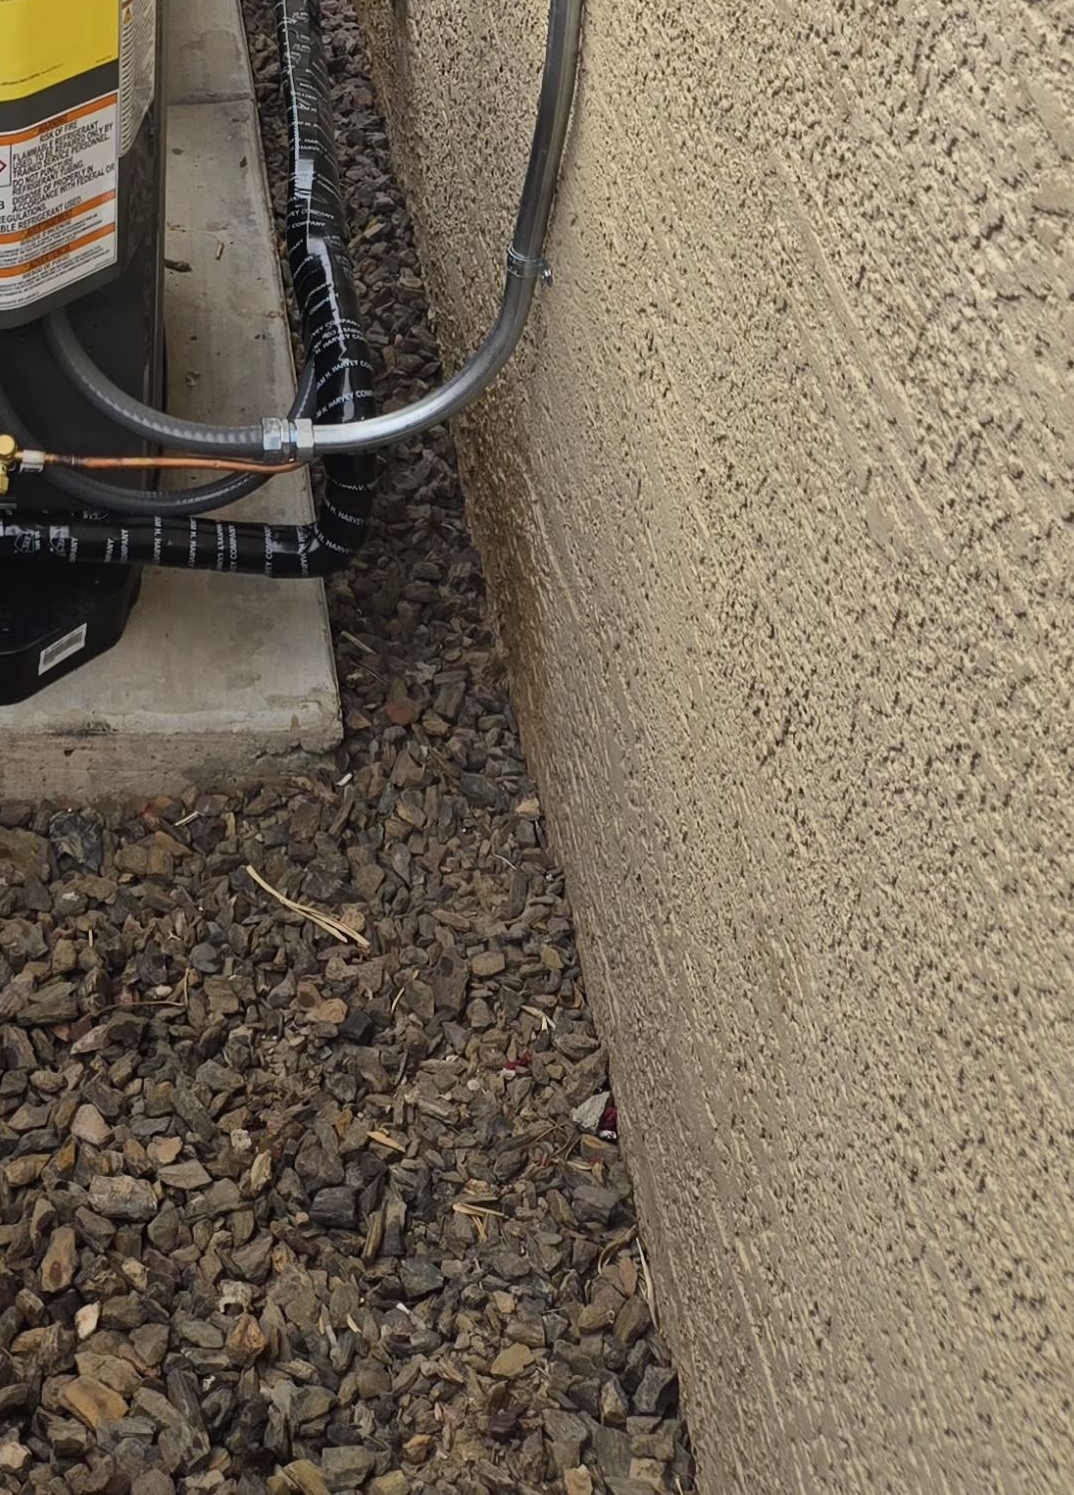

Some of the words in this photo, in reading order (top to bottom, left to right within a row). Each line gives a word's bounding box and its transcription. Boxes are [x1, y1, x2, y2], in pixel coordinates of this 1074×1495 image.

[12, 138, 55, 162] FLAMMABLE
[54, 121, 99, 147] REFRIGERANT
[39, 131, 55, 143] RISK
[55, 126, 64, 138] OF
[64, 120, 78, 133] FIRE
[13, 178, 25, 189] DO
[25, 172, 39, 184] NOT
[17, 203, 64, 231] REFRIGERANT
[331, 360, 359, 373] HARVEY
[328, 391, 355, 409] HARVEY
[228, 525, 237, 560] COMPANY
